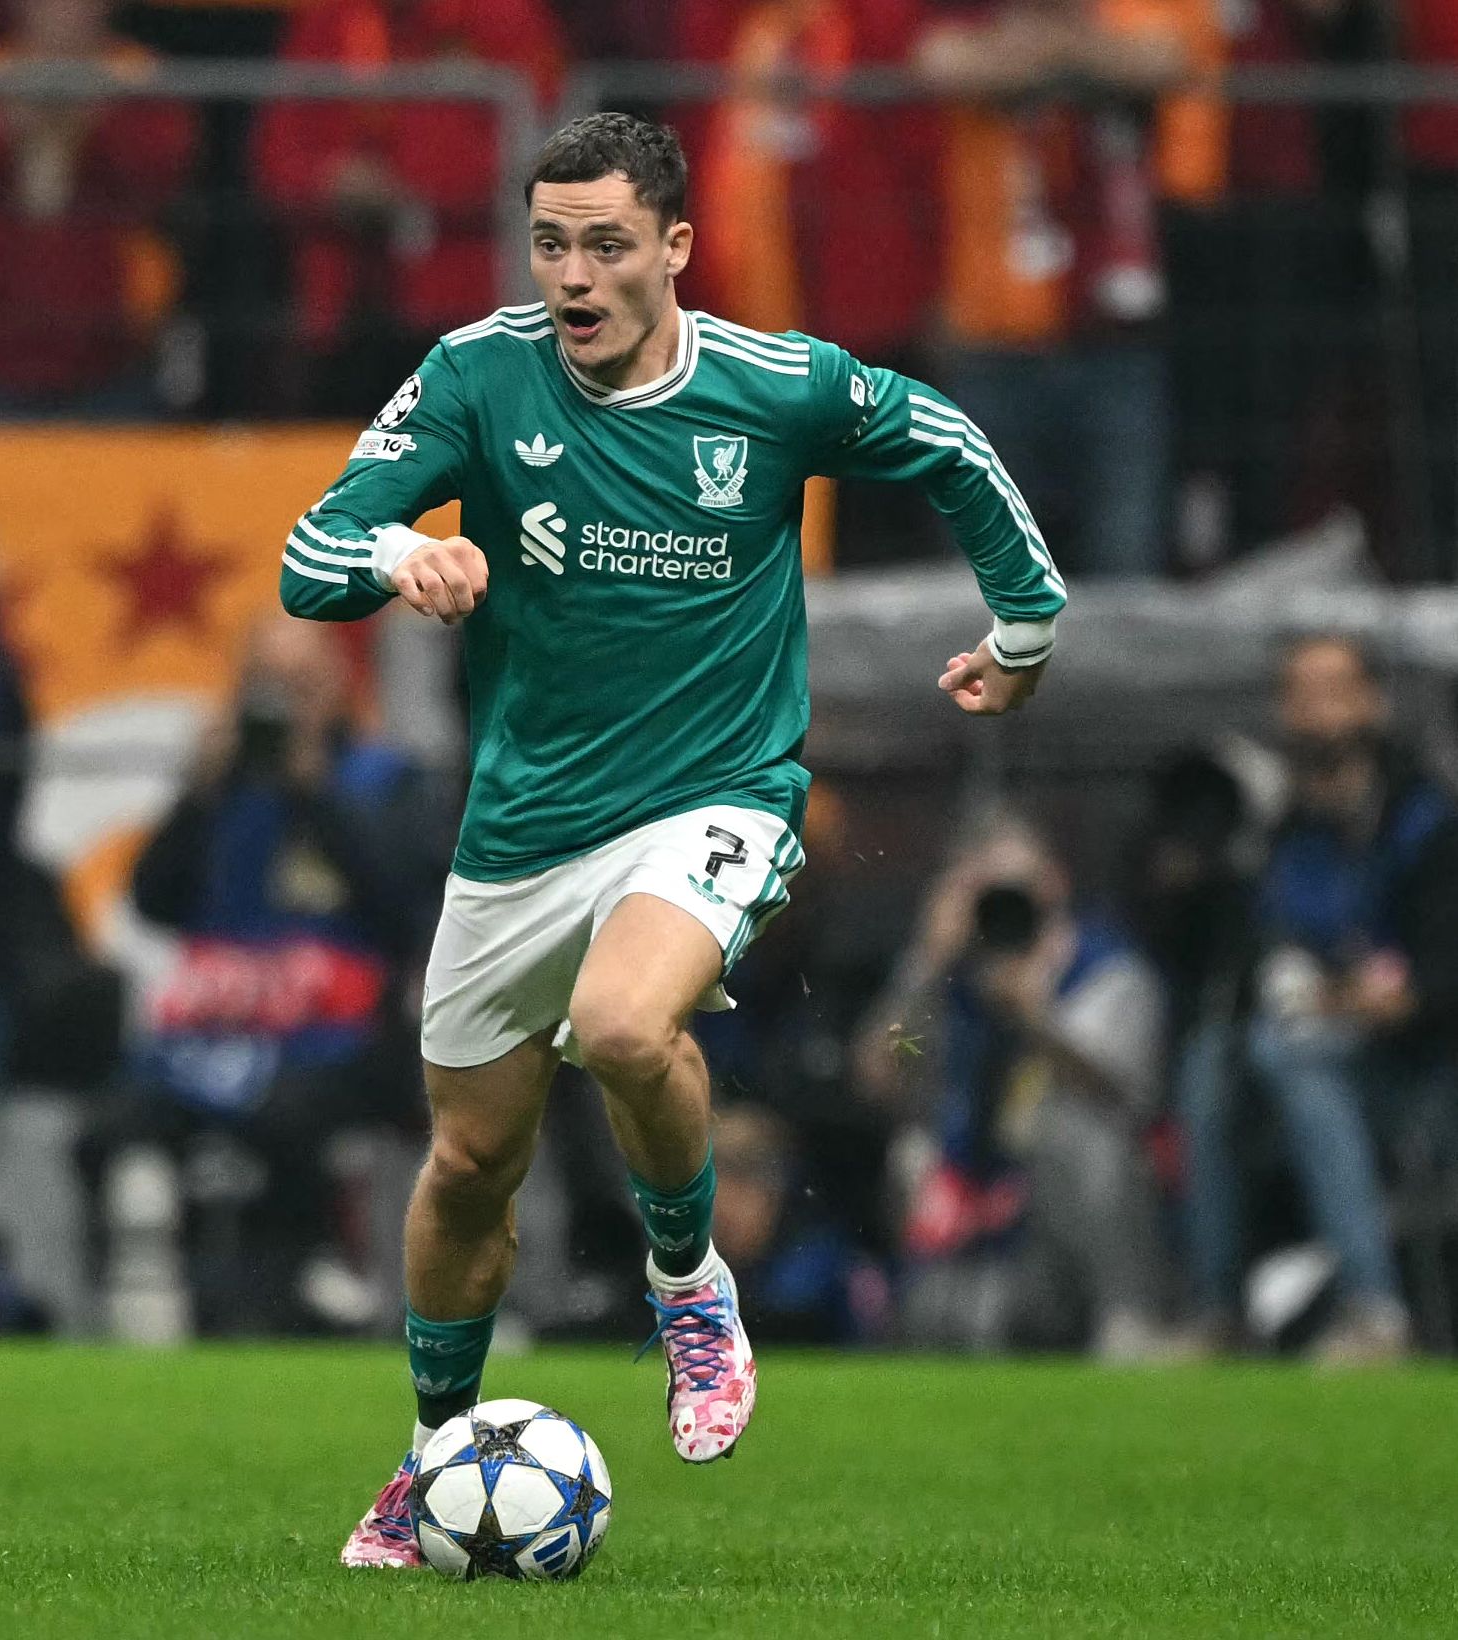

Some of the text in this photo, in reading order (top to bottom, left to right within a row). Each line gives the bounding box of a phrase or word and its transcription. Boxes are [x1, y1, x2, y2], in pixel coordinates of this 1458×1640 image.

[723, 477, 742, 498] POOL
[580, 521, 729, 557] standard
[578, 547, 733, 580] chartered
[705, 824, 749, 879] 7
